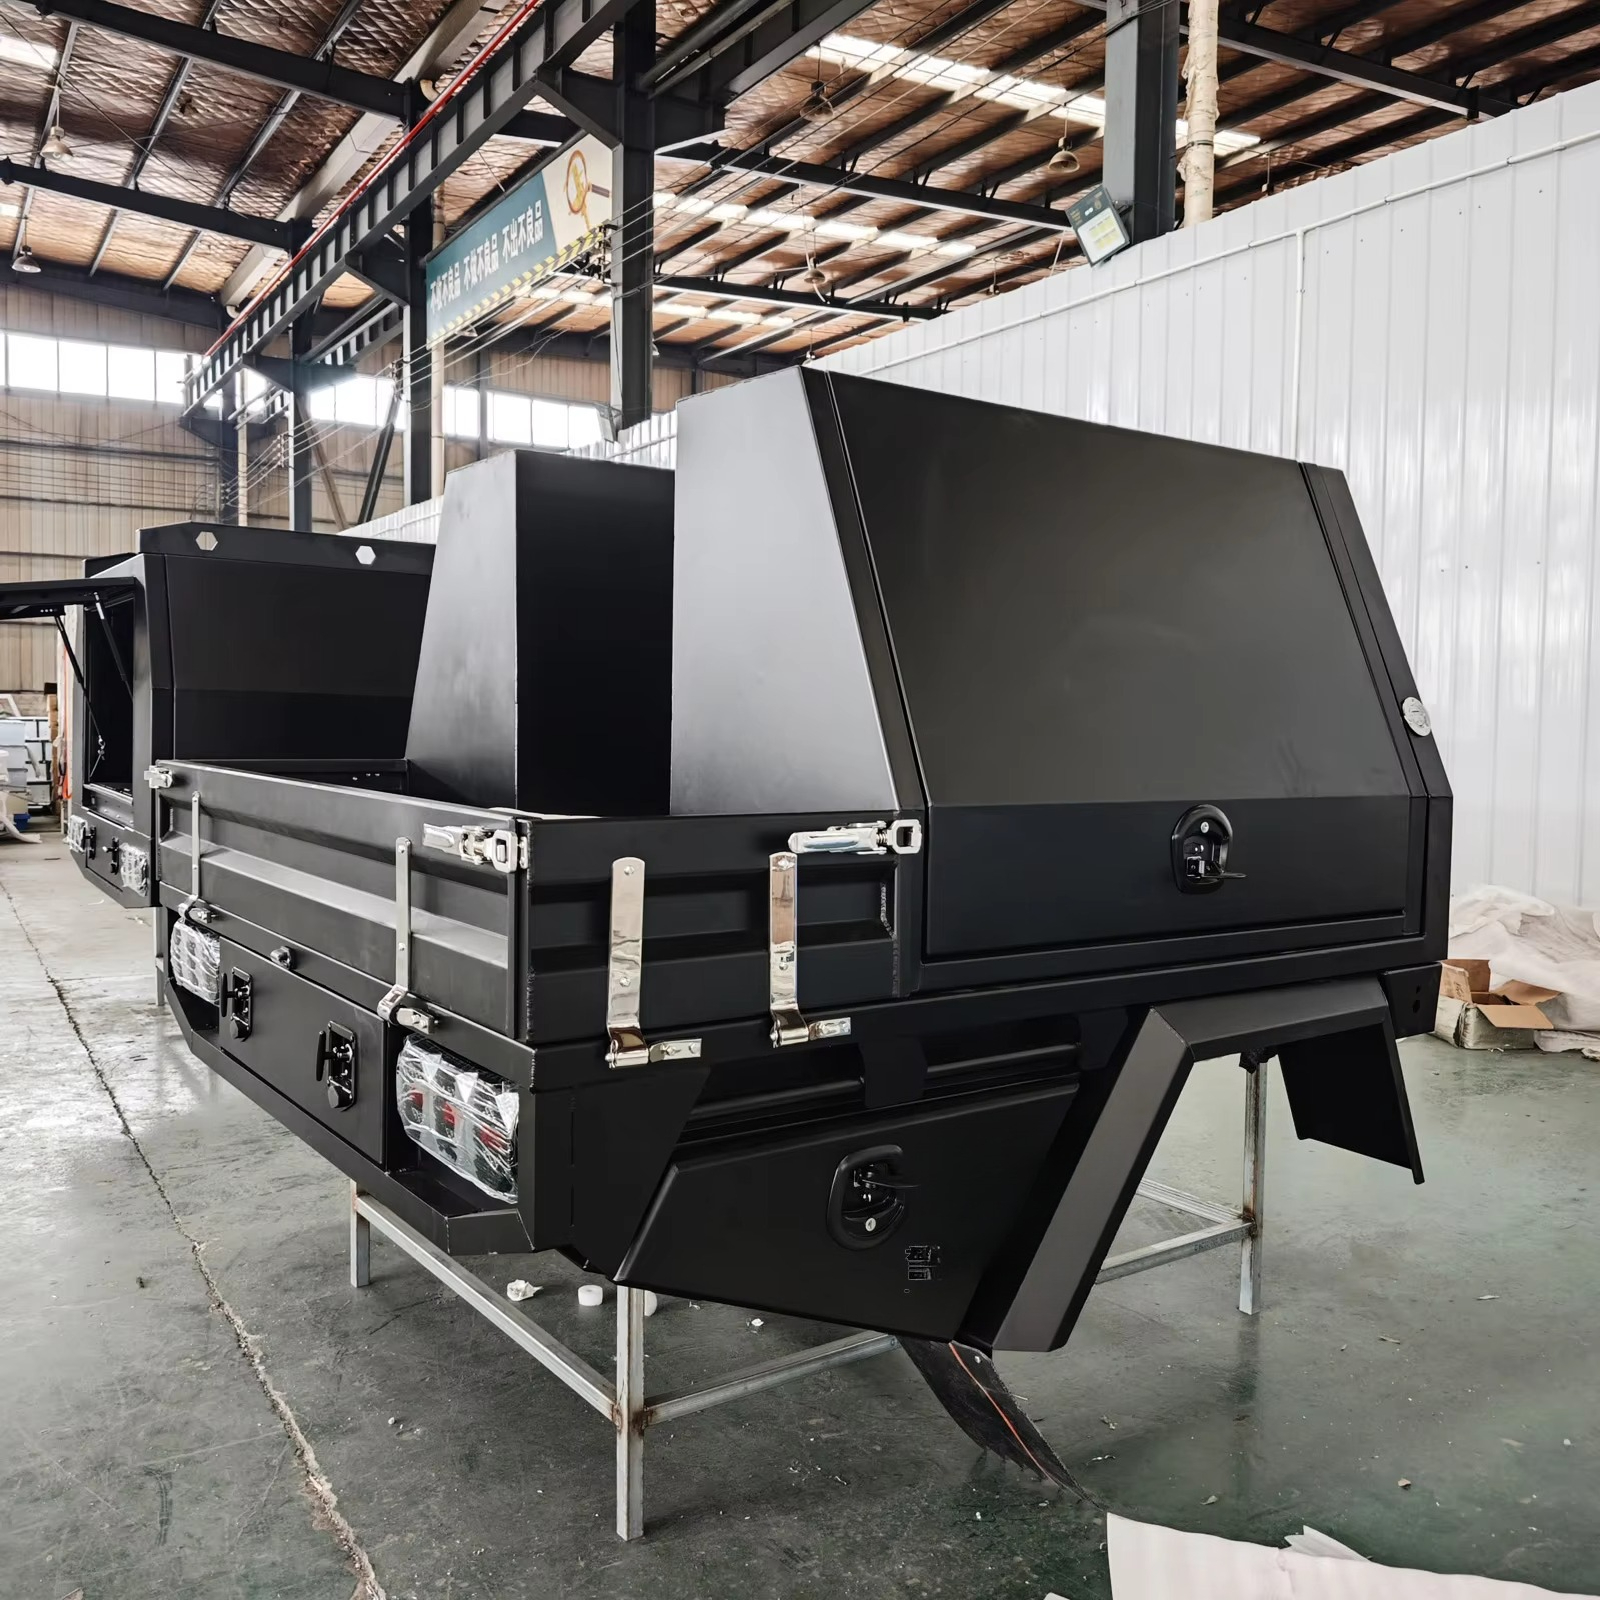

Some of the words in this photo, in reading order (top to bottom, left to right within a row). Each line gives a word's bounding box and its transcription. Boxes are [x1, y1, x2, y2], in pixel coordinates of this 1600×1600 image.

[502, 200, 543, 262] 不出不良品
